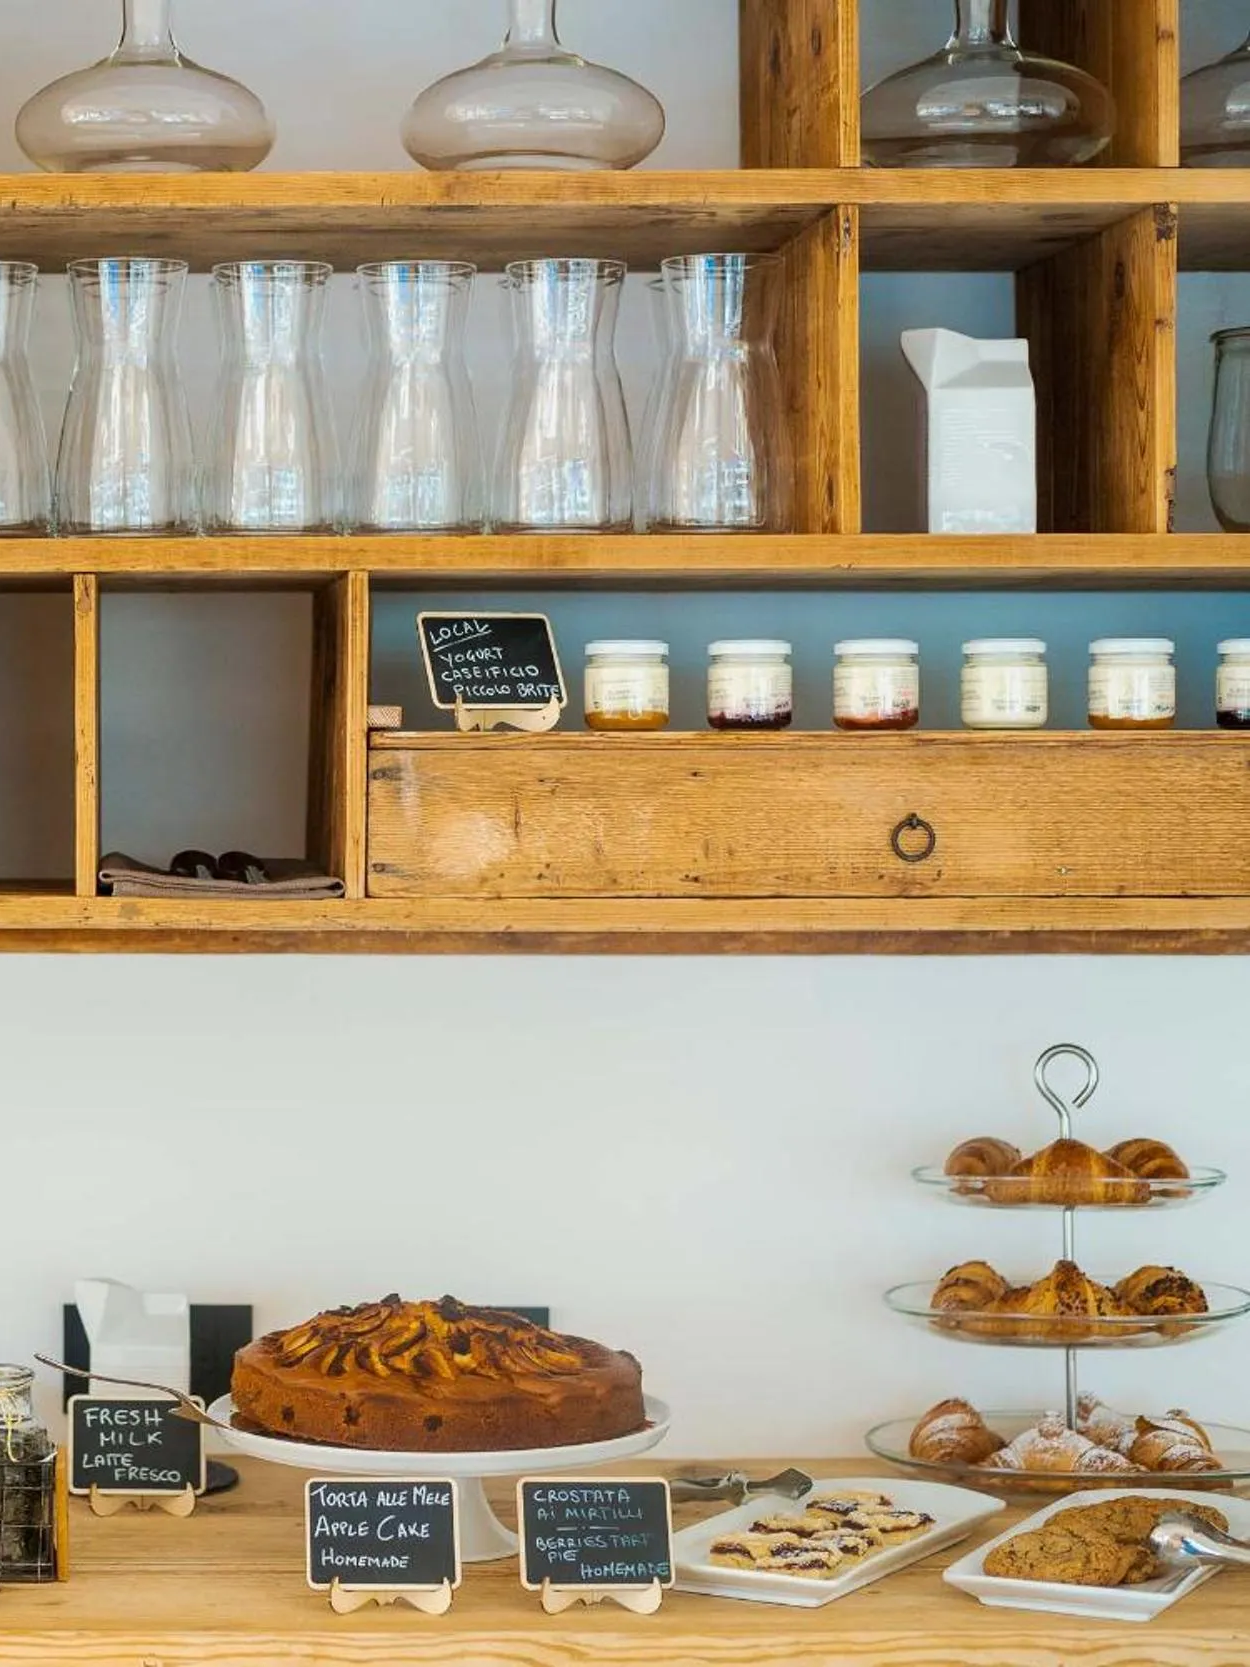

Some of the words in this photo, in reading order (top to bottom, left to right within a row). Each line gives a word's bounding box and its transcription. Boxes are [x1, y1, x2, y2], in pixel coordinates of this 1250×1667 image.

[429, 619, 490, 645] LOCAL
[438, 647, 503, 667] YOGURT
[441, 665, 539, 682] CASEIFICIO
[453, 684, 511, 696] PICCOLO
[83, 1407, 164, 1428] FRESH
[100, 1430, 163, 1447] MILK
[82, 1453, 134, 1468] LATTE
[114, 1466, 181, 1483] FRESCO
[310, 1484, 368, 1508] TORTA
[376, 1490, 408, 1507] ALLE
[412, 1485, 451, 1507] MELE
[533, 1488, 631, 1503] CROSTATA
[565, 1507, 645, 1521] MIRTILLI
[314, 1514, 369, 1538] APPLE
[376, 1515, 431, 1541] CAKE
[536, 1534, 608, 1551] BERRIES
[321, 1547, 411, 1569] HOMEMADE
[548, 1549, 579, 1563] PIE
[580, 1561, 670, 1579] HOMEMADE
